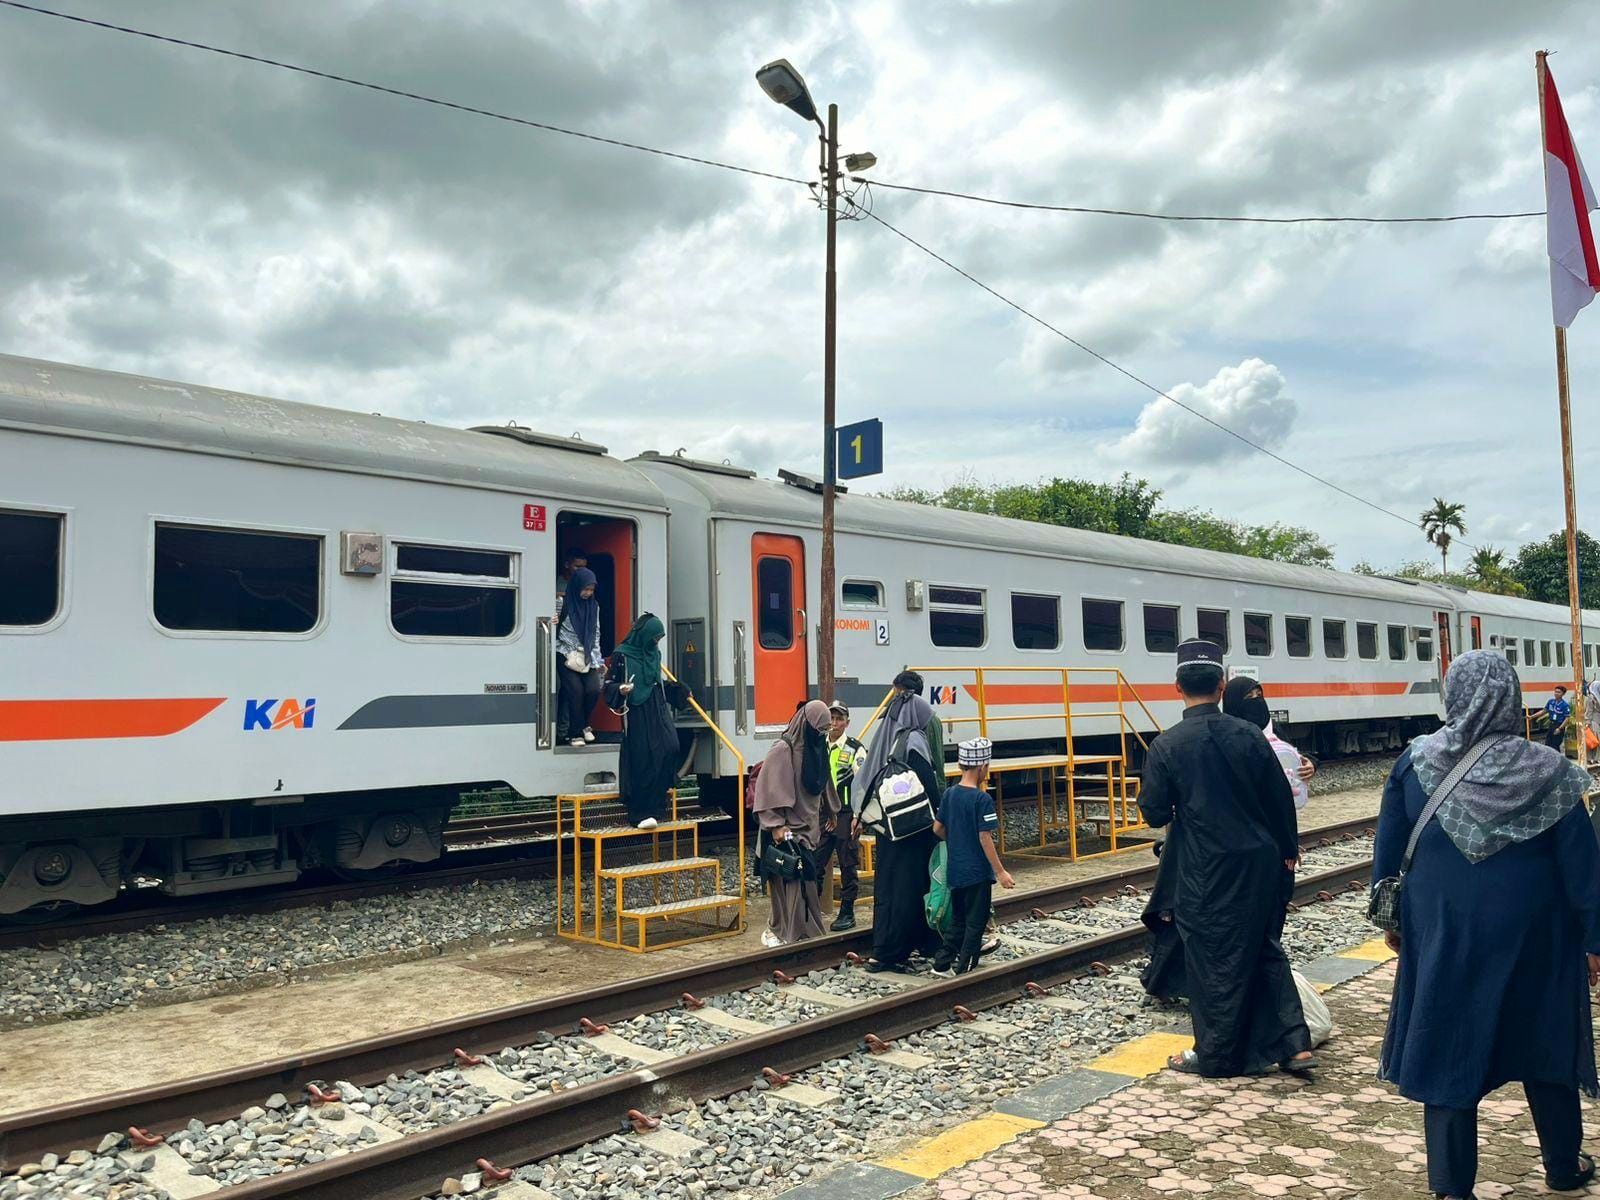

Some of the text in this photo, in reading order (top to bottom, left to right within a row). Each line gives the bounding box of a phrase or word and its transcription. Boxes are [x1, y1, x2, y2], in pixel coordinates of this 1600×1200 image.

[851, 435, 862, 464] 1
[530, 506, 540, 518] E
[879, 625, 886, 639] 2
[930, 685, 957, 705] KAI
[243, 698, 316, 731] KAI
